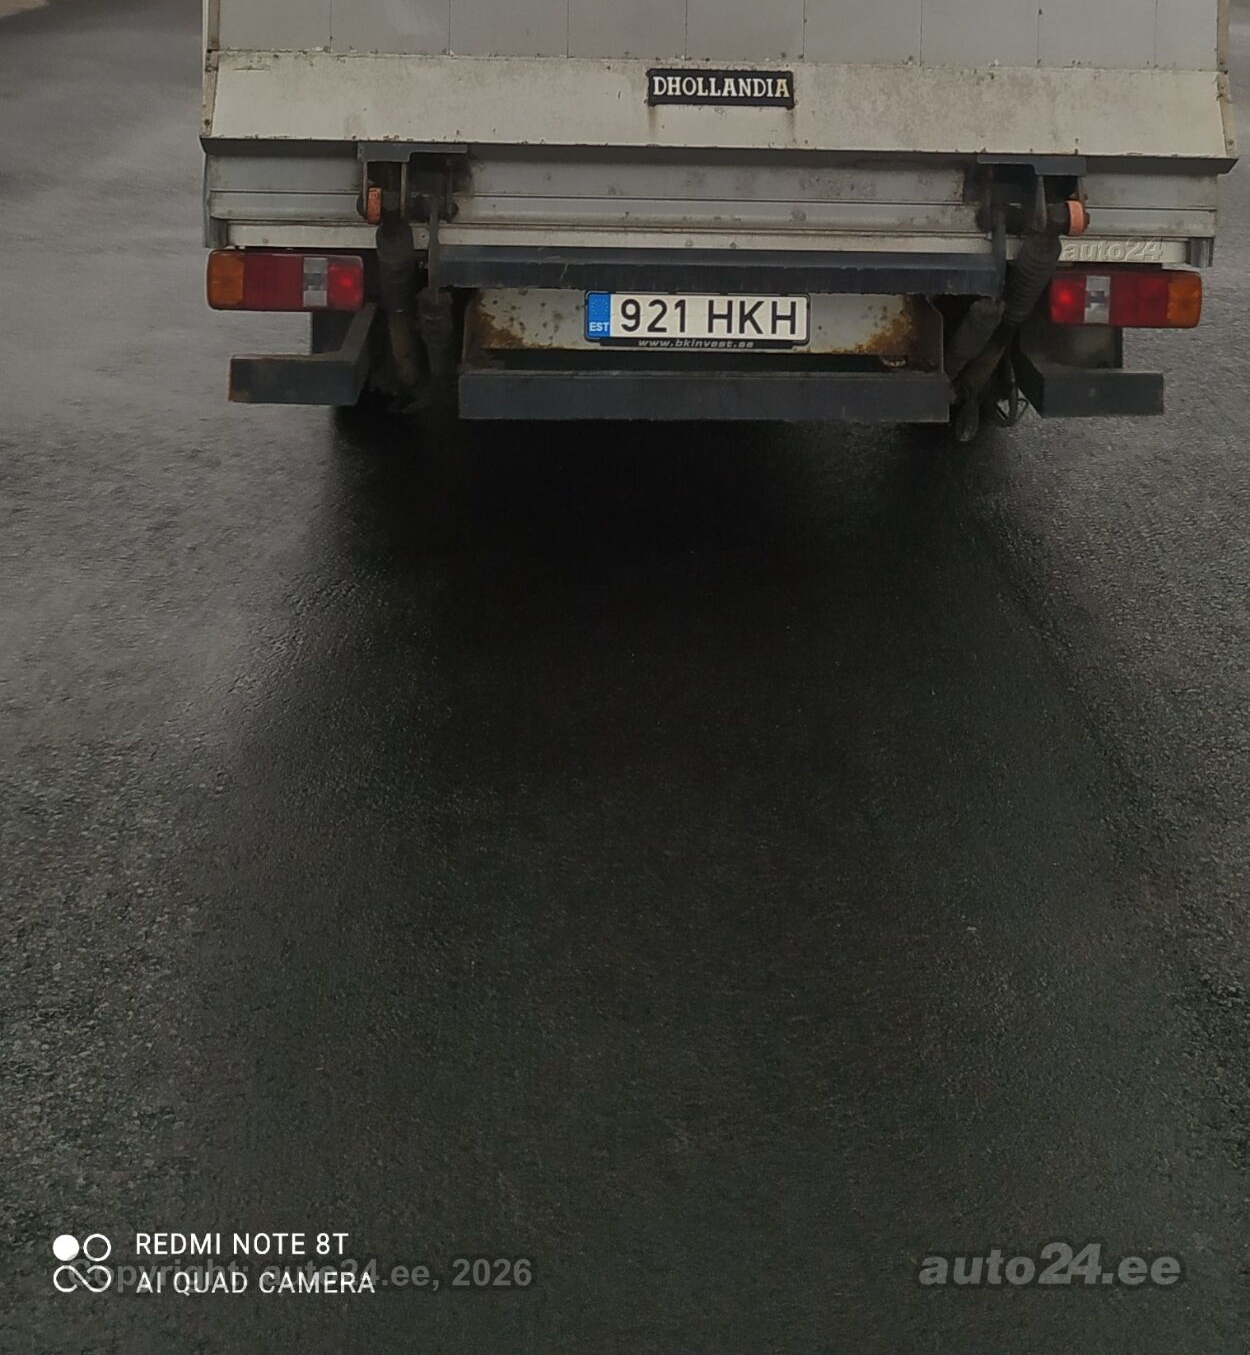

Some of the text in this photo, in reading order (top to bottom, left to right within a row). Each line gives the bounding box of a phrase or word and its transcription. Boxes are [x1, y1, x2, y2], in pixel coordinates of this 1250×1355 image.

[653, 76, 790, 97] DHOLLANDIA
[589, 299, 796, 334] EST 921 HKH
